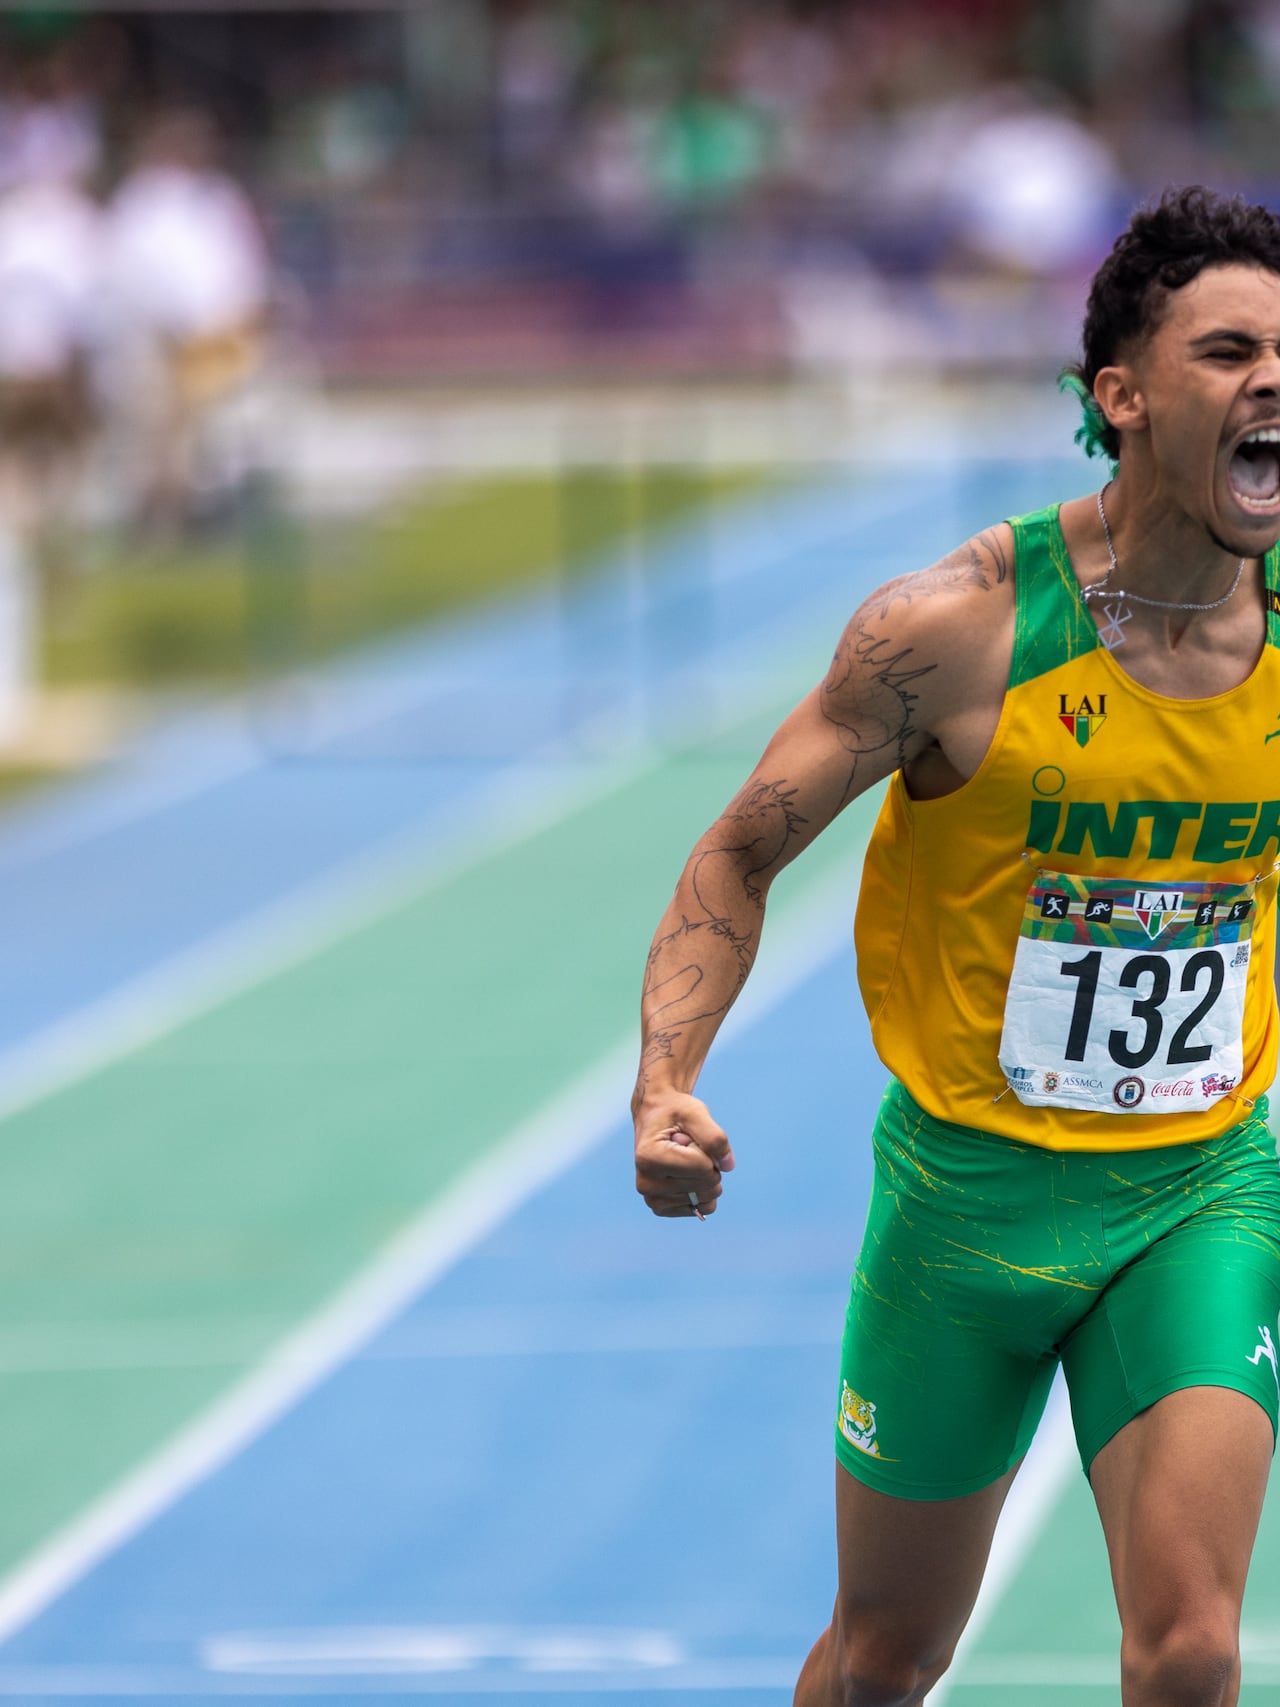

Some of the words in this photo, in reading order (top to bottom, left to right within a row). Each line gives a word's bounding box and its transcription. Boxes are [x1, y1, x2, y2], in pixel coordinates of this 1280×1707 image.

[1058, 694, 1108, 715] LAI
[1136, 892, 1181, 911] LAI
[1060, 950, 1225, 1069] 132
[1063, 1077, 1104, 1089] ASSMCA
